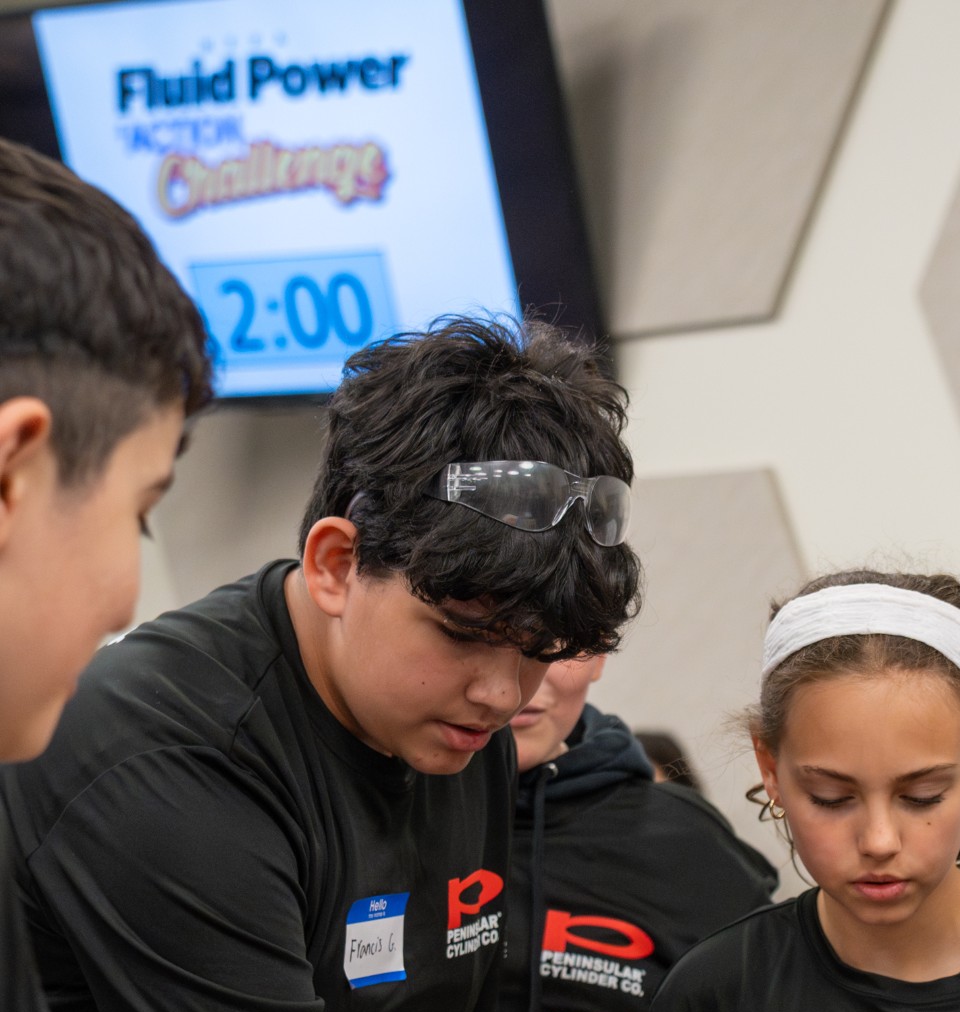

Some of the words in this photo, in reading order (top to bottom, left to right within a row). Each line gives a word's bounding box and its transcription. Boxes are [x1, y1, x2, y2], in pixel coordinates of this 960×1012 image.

[117, 60, 236, 112] Fluid
[247, 55, 408, 100] Power
[157, 140, 390, 219] Challenge
[219, 272, 374, 352] 2:00
[369, 898, 387, 912] Hello
[350, 936, 383, 962] Francis
[541, 949, 644, 983] PENINSULAR
[540, 962, 619, 990] CYLINDER
